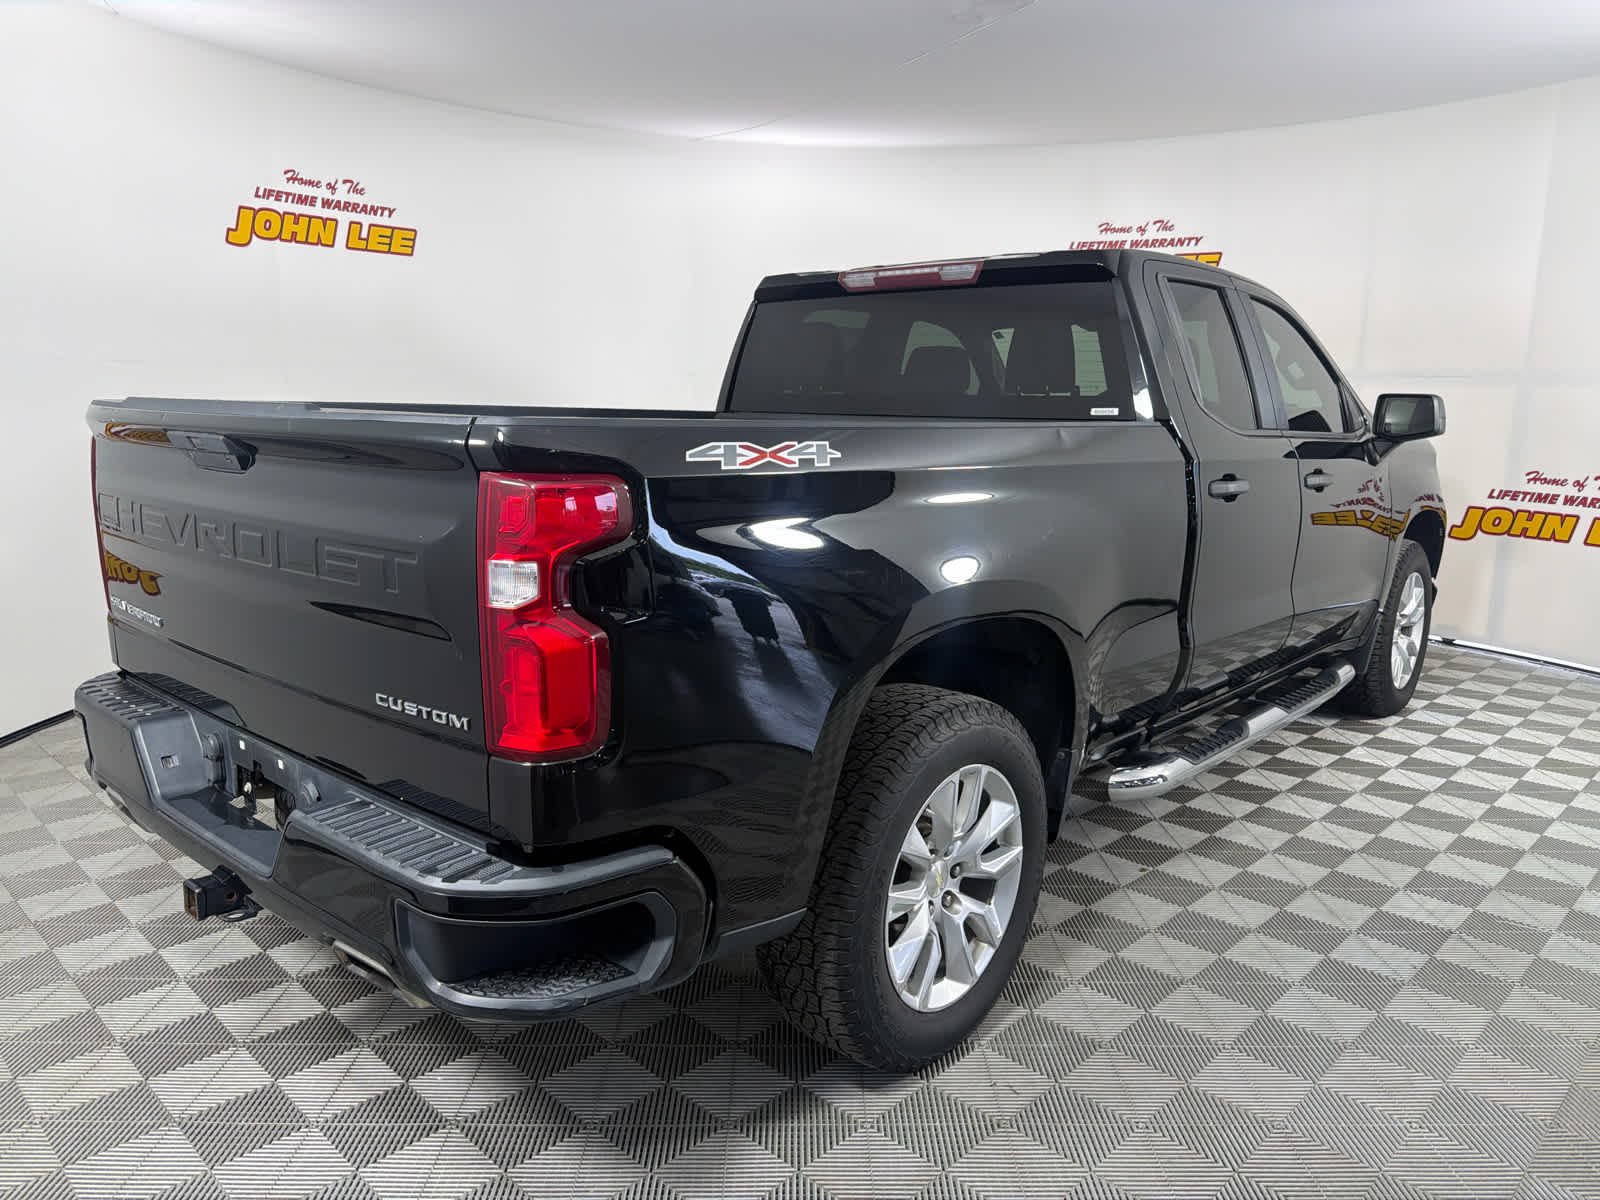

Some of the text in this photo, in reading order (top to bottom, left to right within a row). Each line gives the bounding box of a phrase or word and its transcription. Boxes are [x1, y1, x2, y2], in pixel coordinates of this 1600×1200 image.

[283, 169, 366, 196] Home of The
[254, 186, 396, 219] LIFETIME WARRANTY
[226, 205, 418, 256] JOHN LEE
[1098, 219, 1175, 236] Home of The
[1068, 236, 1203, 250] LIFETIME WARRANTY
[1525, 470, 1569, 487] Home
[1572, 475, 1589, 492] of
[1488, 488, 1561, 505] LIFETIME
[1448, 505, 1580, 543] JOHN
[97, 491, 419, 594] CHEVROLET
[375, 692, 471, 731] CUSTOM
